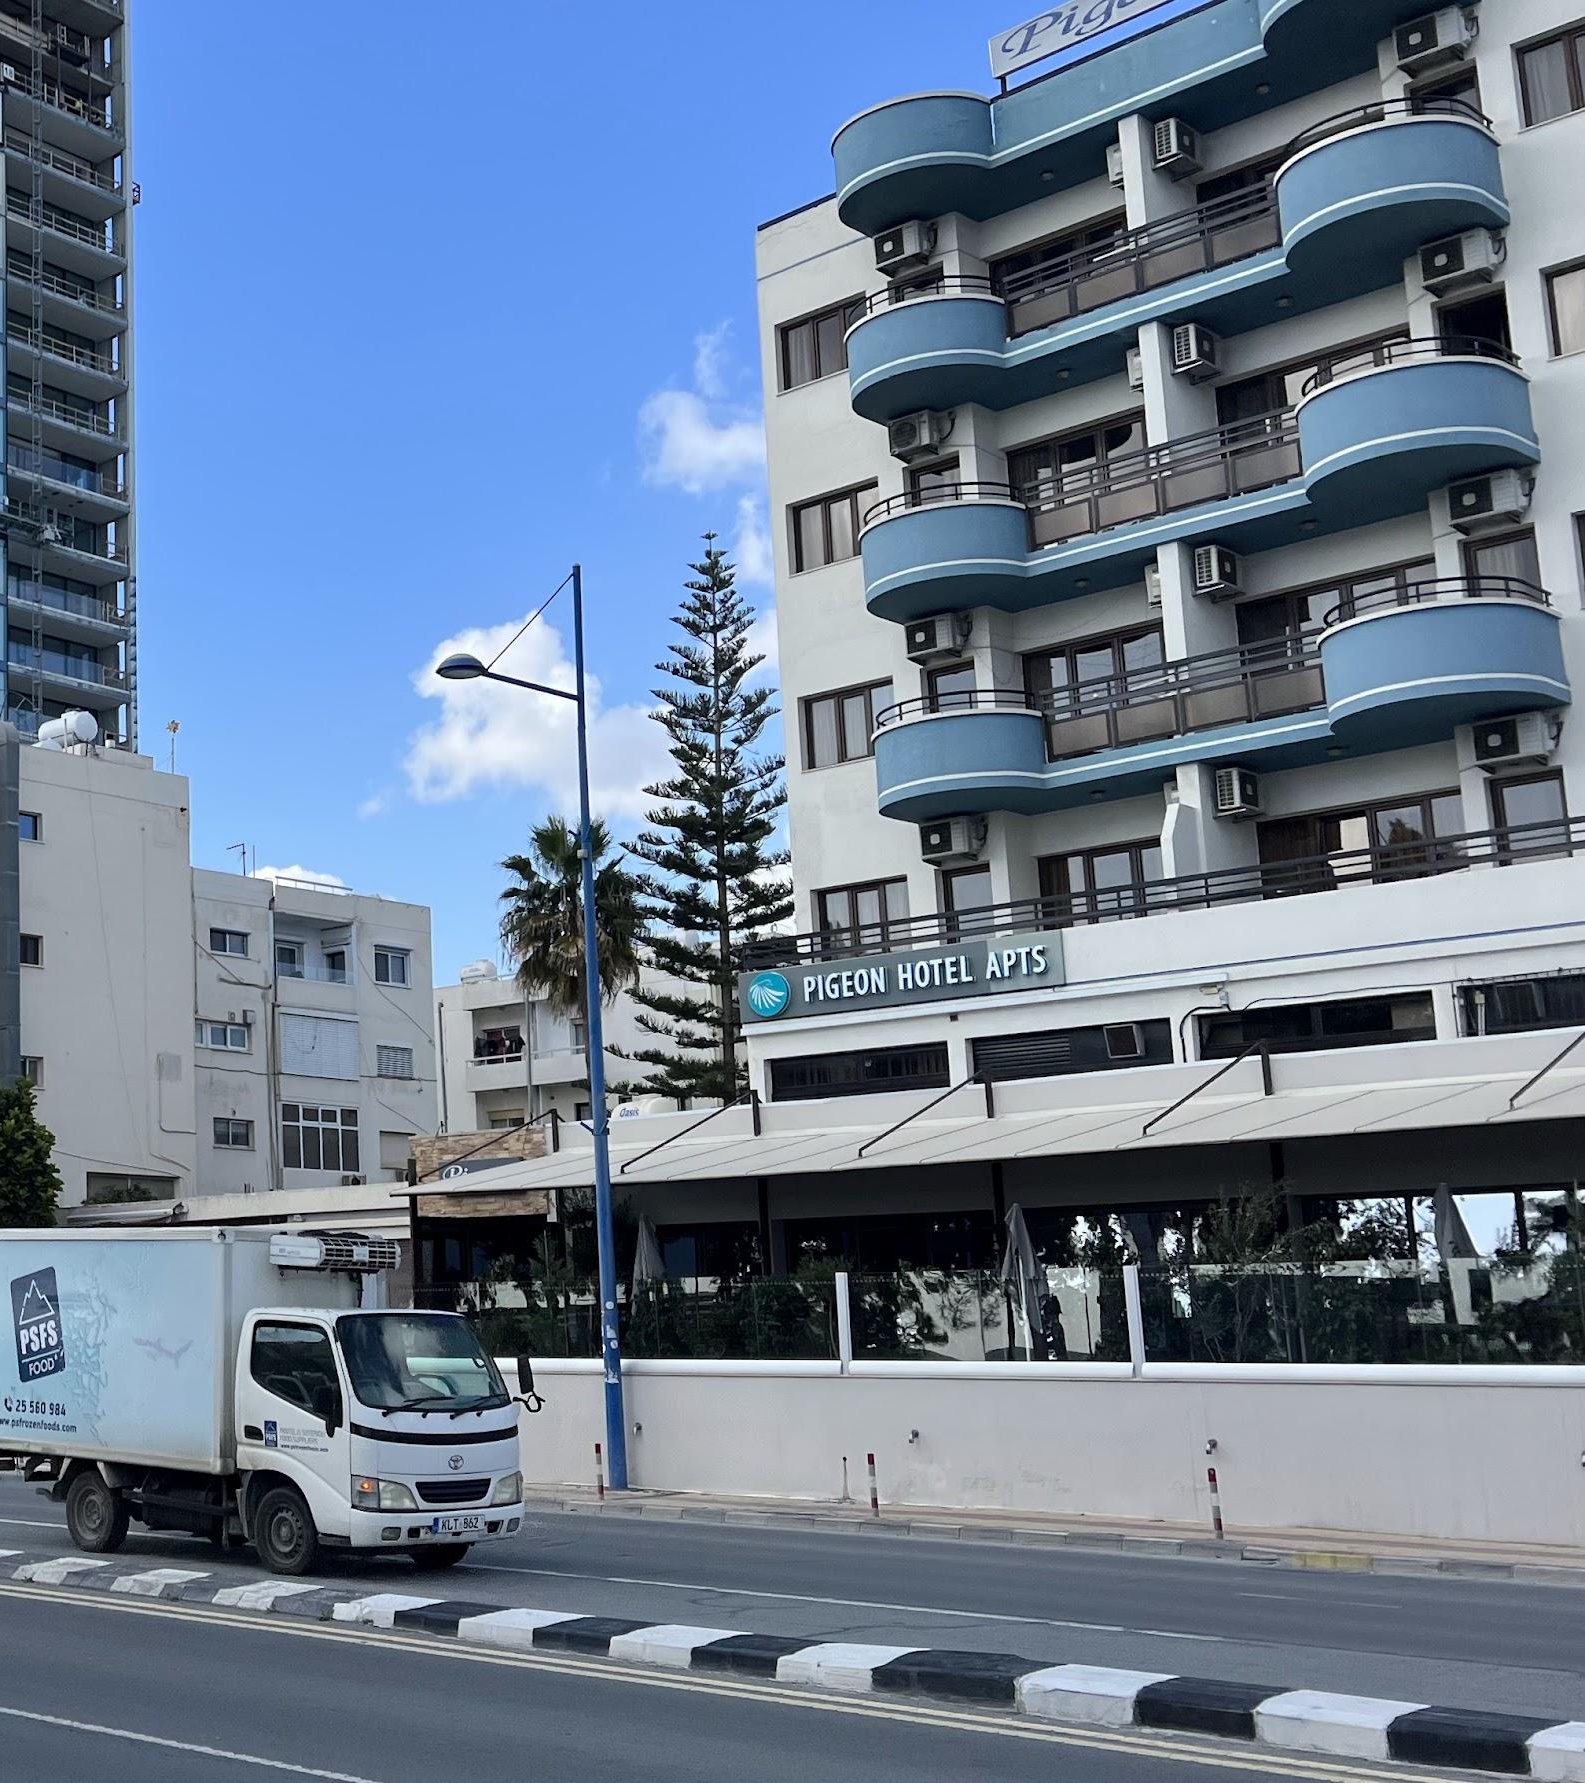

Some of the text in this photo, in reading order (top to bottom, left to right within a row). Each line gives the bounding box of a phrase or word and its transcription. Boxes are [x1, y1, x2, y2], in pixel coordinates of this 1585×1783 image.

[803, 945, 1048, 1002] PIGEON HOTEL APTS
[619, 1107, 640, 1117] Oasis
[20, 1319, 58, 1355] PSFS
[28, 1358, 55, 1376] FOOD
[15, 1400, 27, 1412] 25
[49, 1402, 66, 1417] 984
[441, 1517, 479, 1531] KLT 862
